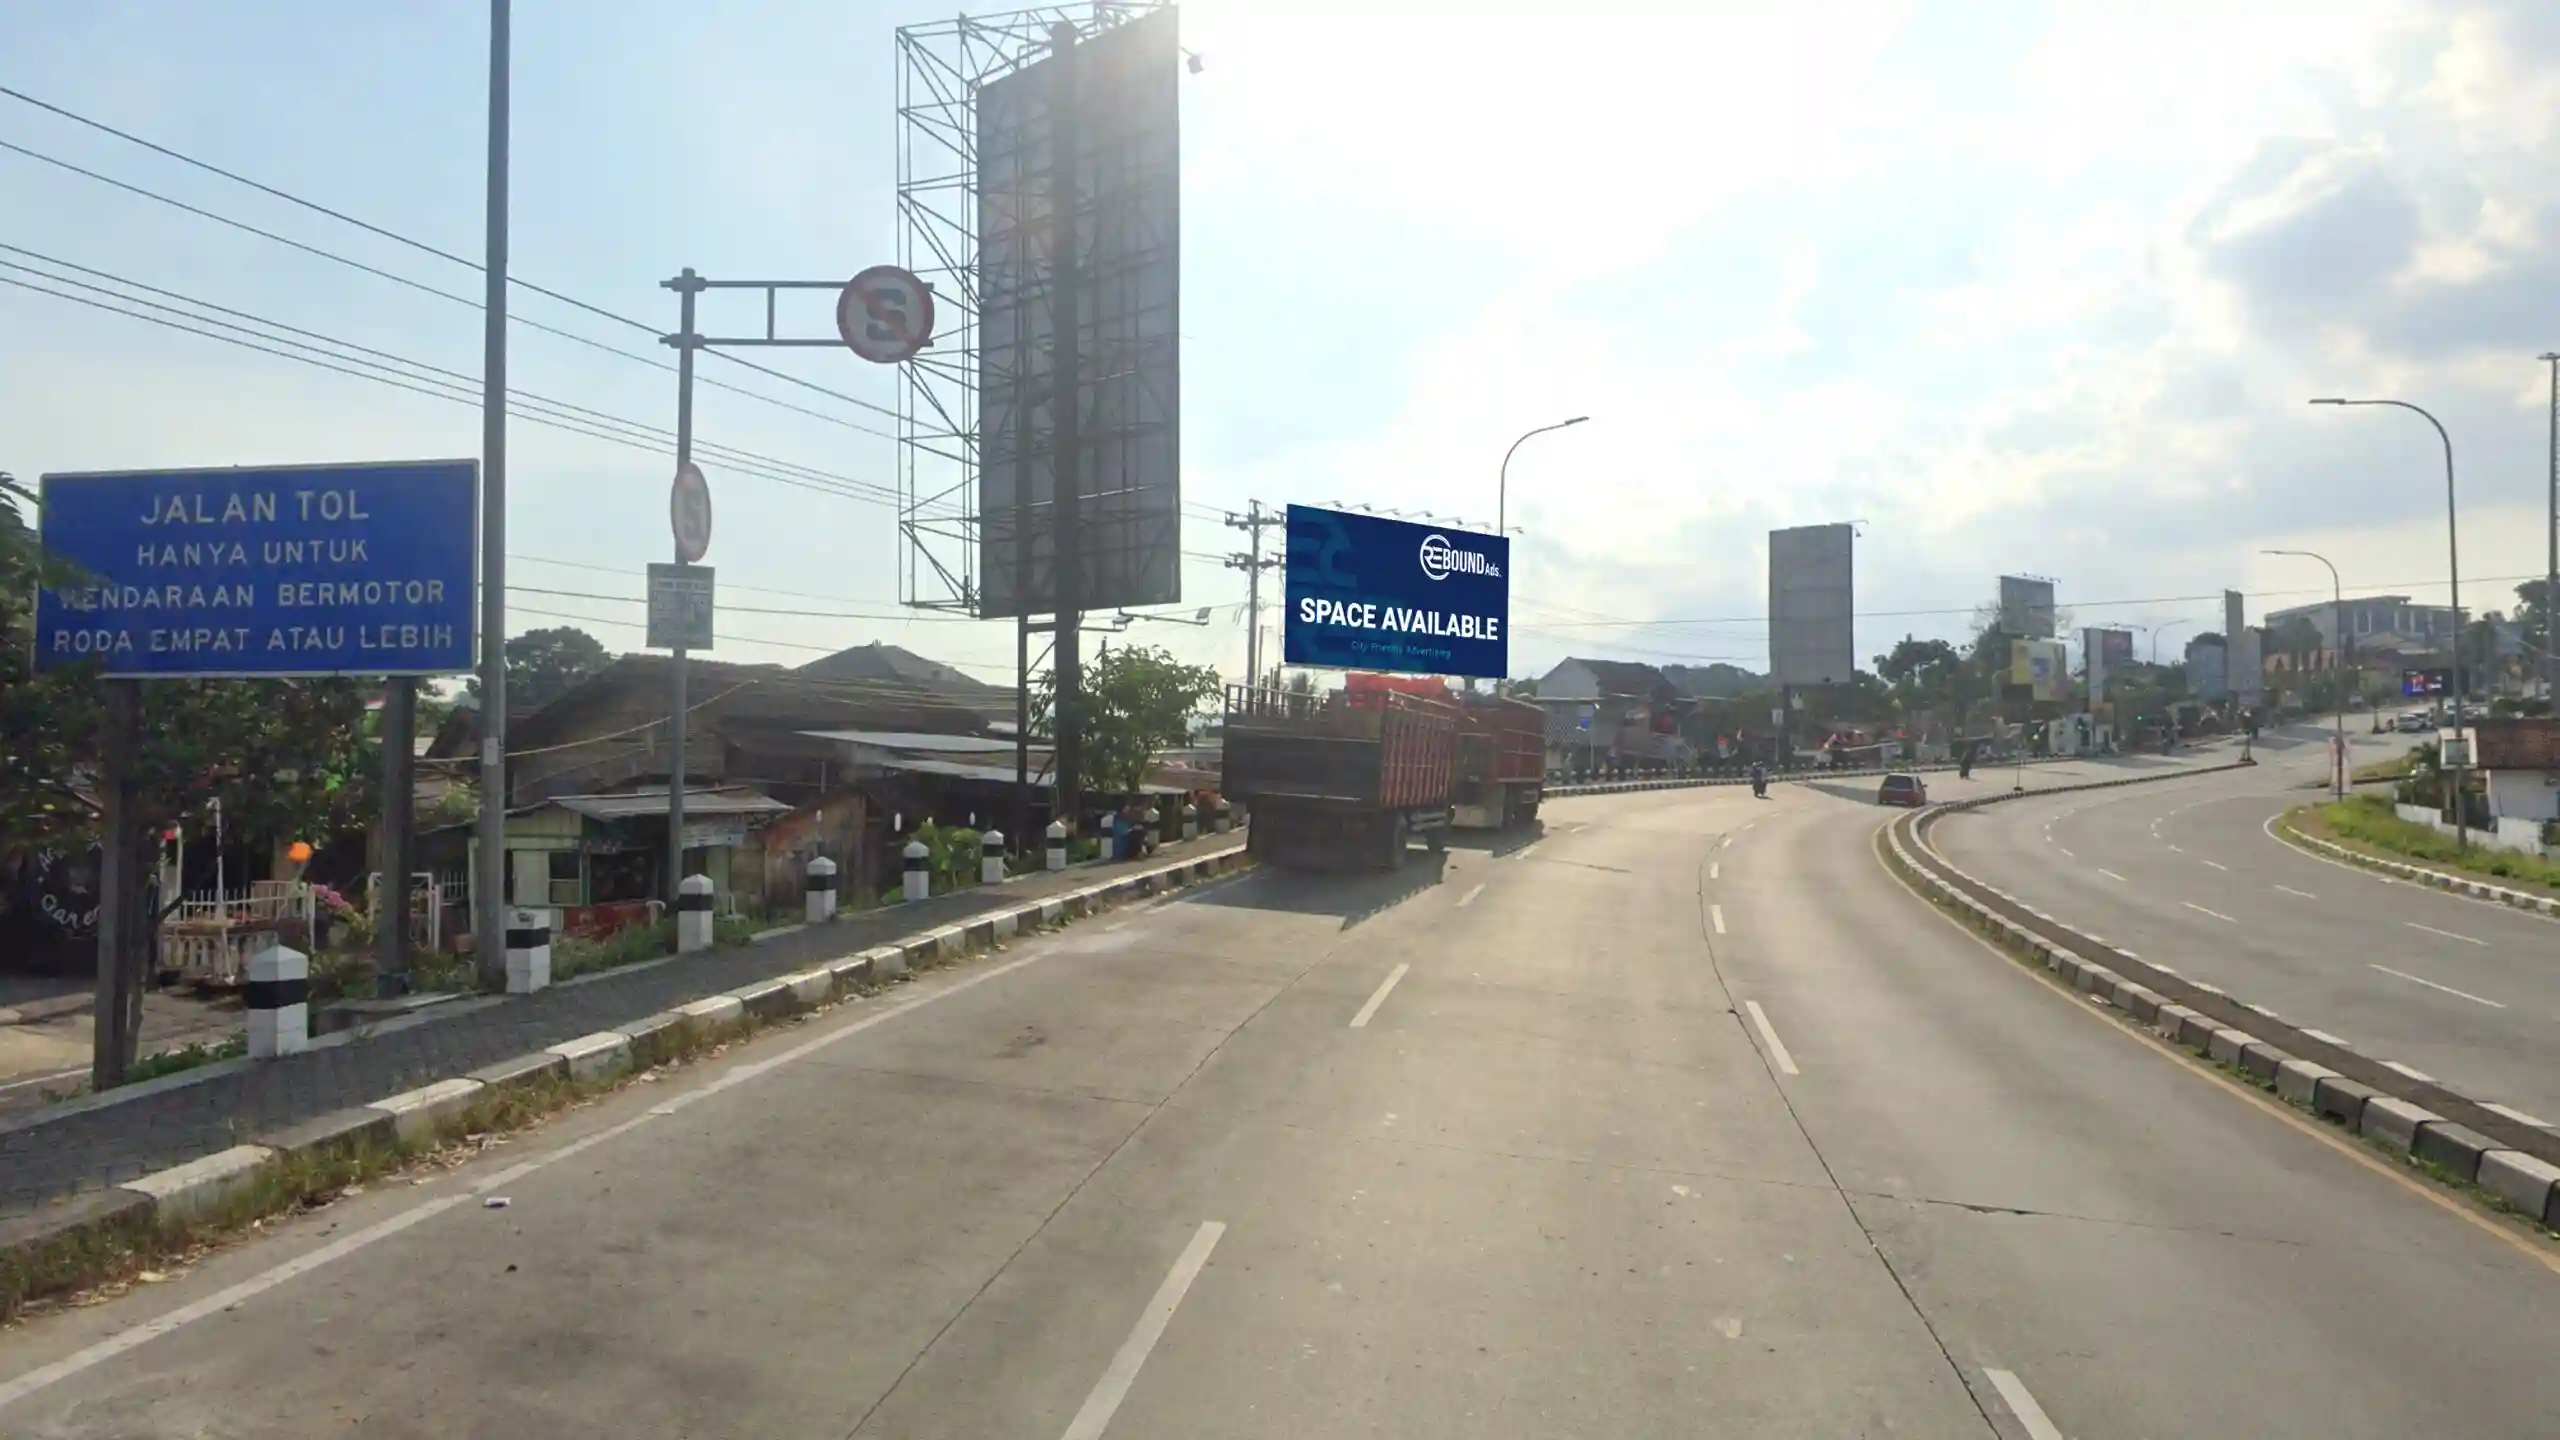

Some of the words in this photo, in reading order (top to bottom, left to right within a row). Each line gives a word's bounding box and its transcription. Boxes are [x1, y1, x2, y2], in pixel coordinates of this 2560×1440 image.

[140, 491, 276, 525] JALAN
[295, 489, 369, 521] TOL
[137, 542, 247, 566] HANYA
[263, 539, 368, 563] UNTUK
[1421, 538, 1484, 577] REBOUND
[278, 580, 444, 606] BERMOTOR
[1300, 598, 1376, 628] SPACE
[1382, 607, 1498, 640] AVAILABLE
[54, 630, 133, 652] RODA
[151, 628, 250, 652] EMPAT
[267, 626, 344, 650] ATAU
[360, 624, 452, 649] LEBIH
